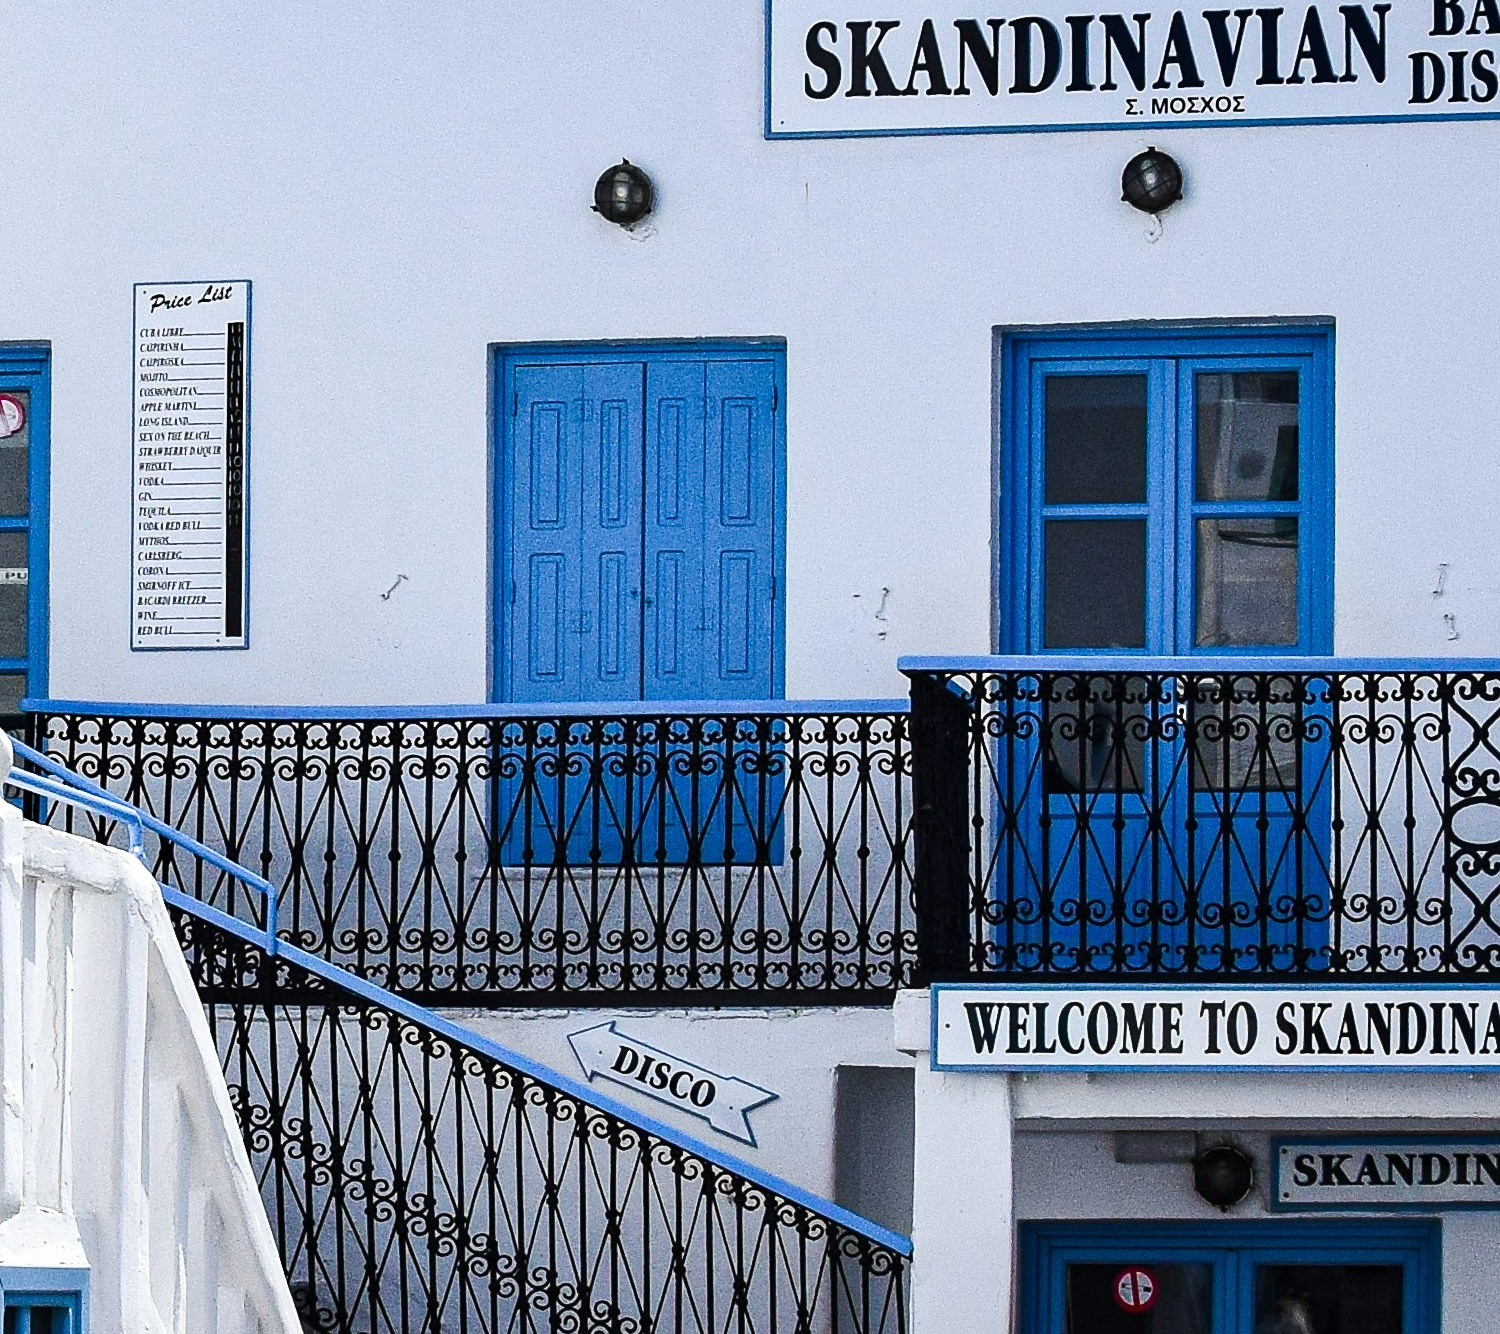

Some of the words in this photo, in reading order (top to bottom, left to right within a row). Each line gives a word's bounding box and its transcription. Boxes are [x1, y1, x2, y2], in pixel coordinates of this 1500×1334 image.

[804, 2, 1391, 99] SKANDINAVIAN
[1150, 94, 1246, 115] ΜΟΣΧΟΣ
[150, 294, 192, 314] Price
[198, 285, 233, 305] List
[963, 998, 1186, 1057] WELCOME
[1200, 998, 1261, 1056] TO
[610, 1045, 717, 1107] DISCO
